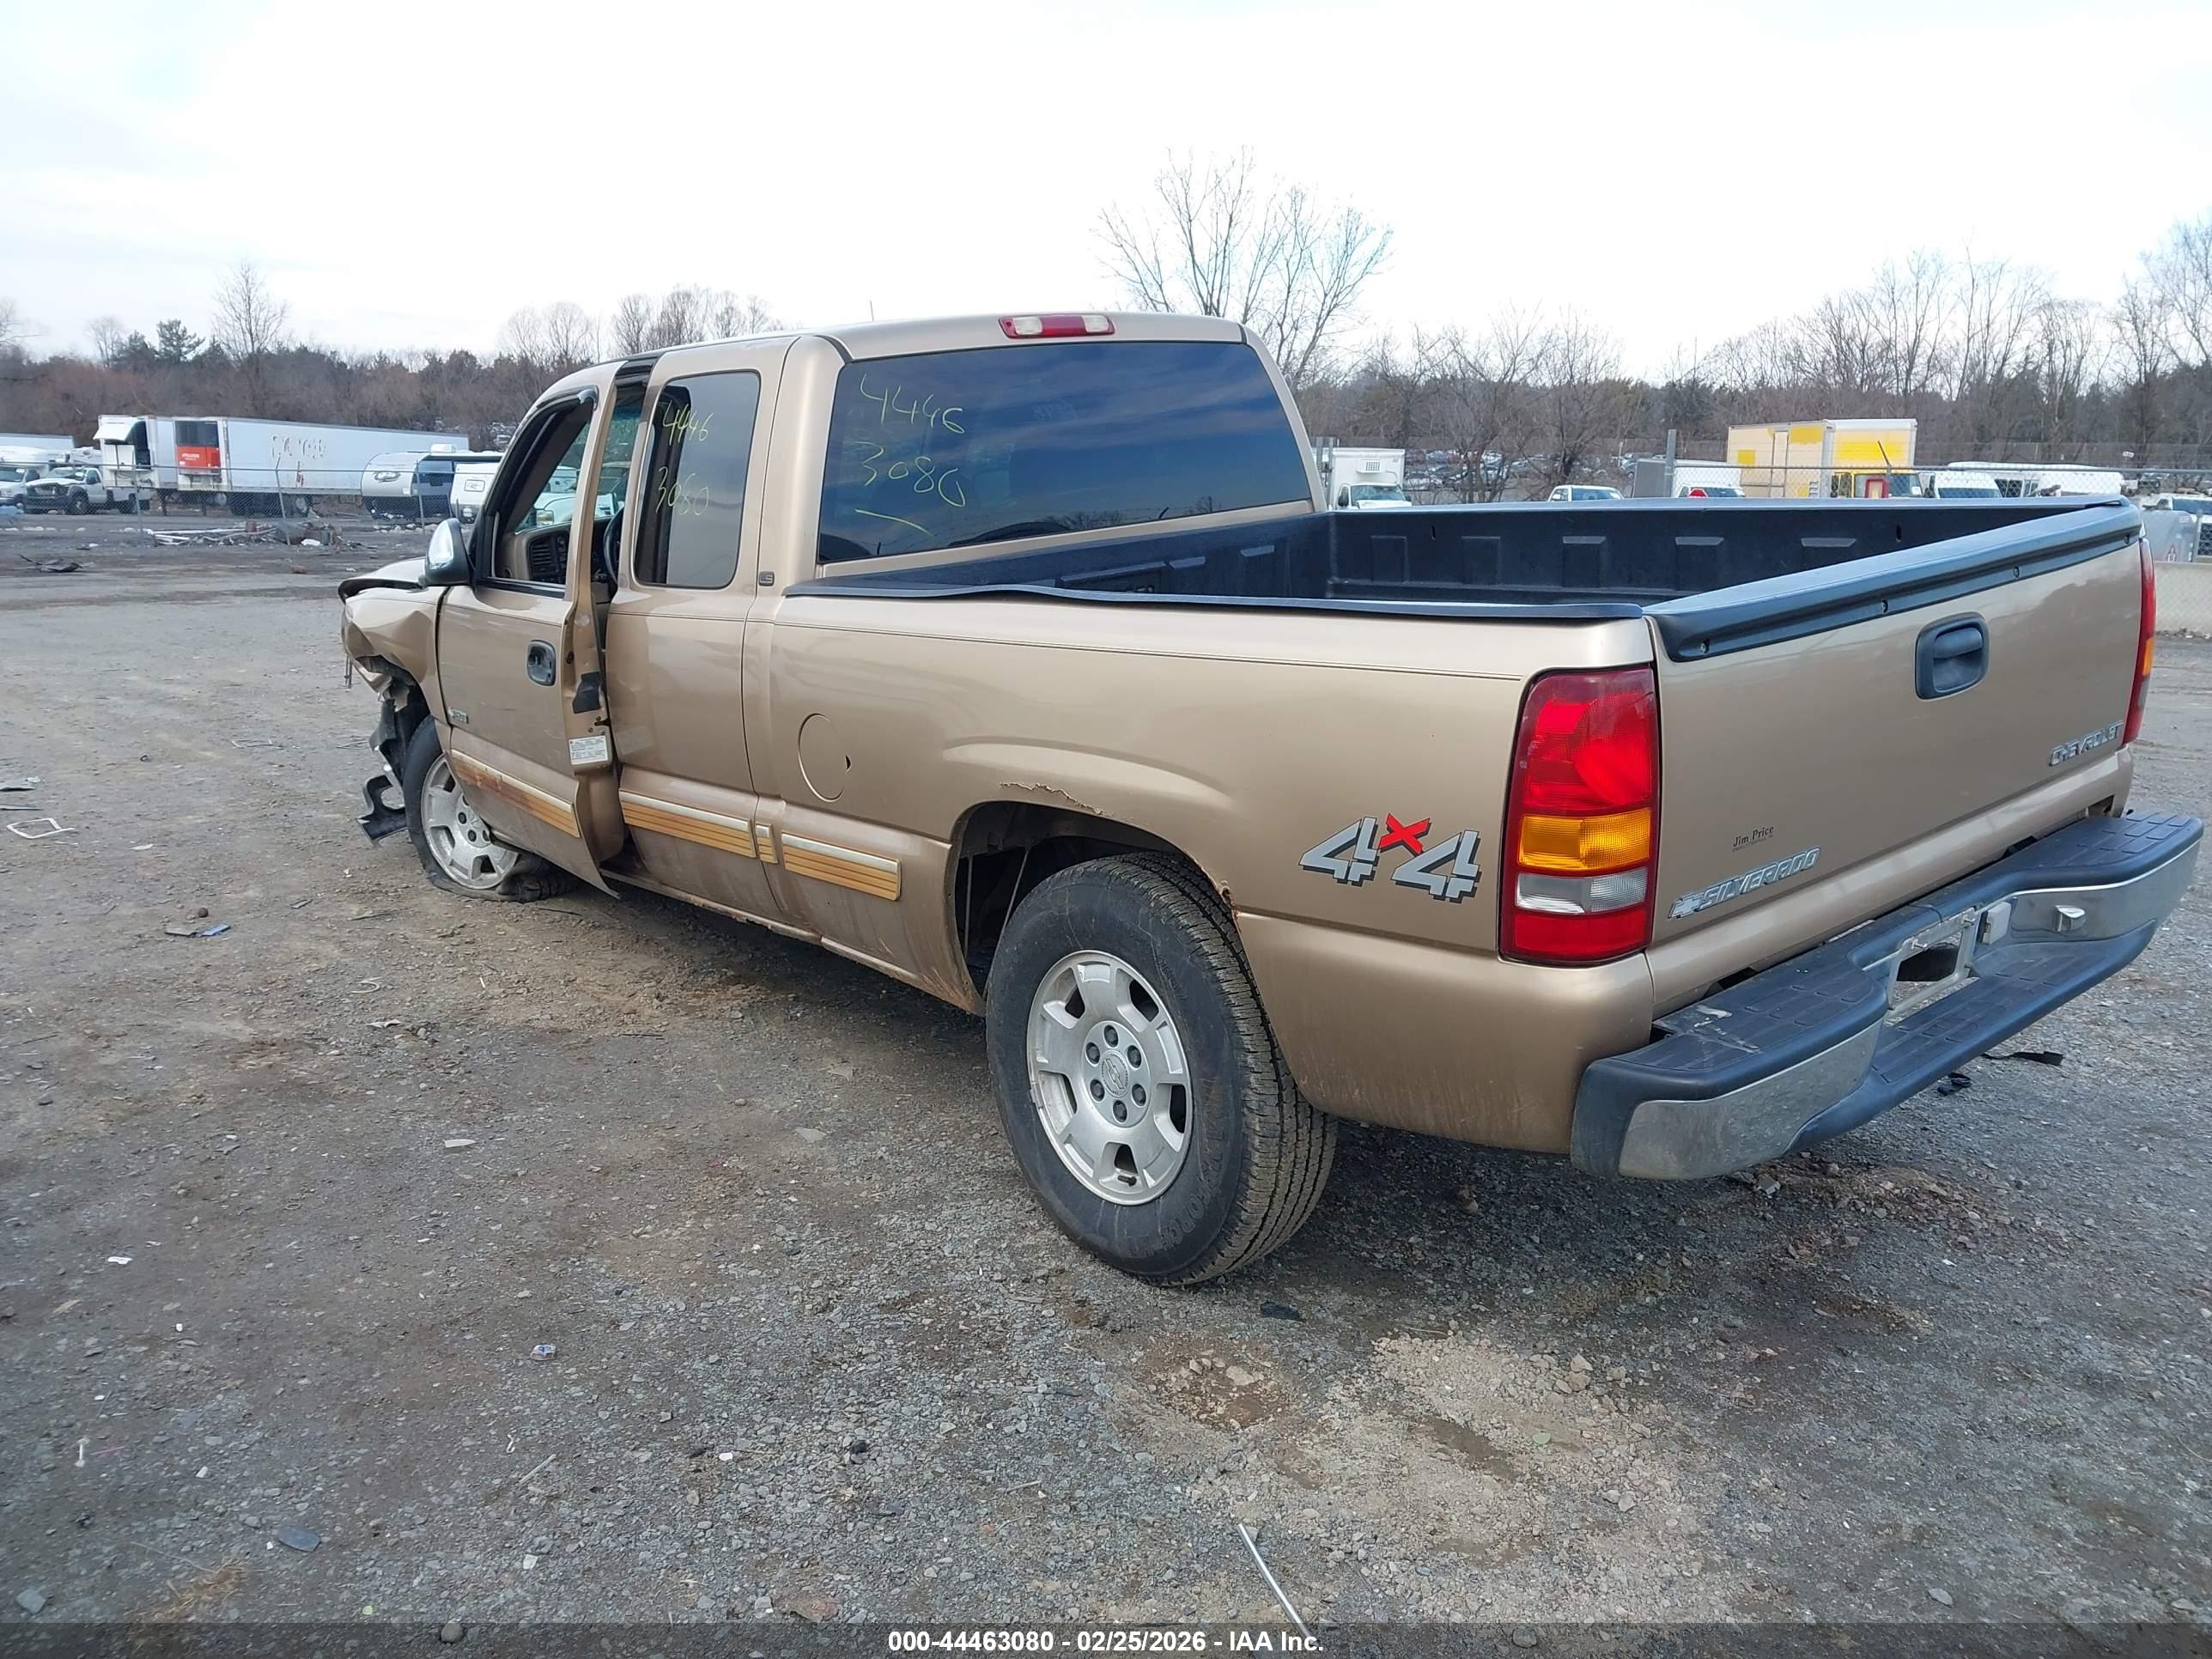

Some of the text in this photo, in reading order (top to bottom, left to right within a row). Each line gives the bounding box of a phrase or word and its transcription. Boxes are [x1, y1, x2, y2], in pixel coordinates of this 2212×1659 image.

[661, 401, 714, 446] 4446
[860, 372, 964, 434] 4446
[854, 441, 967, 507] 3080
[2048, 720, 2124, 767] CHEVROLET
[1733, 836, 1749, 848] Jim
[1752, 825, 1774, 841] Price
[1698, 847, 1821, 910] SILVERADO
